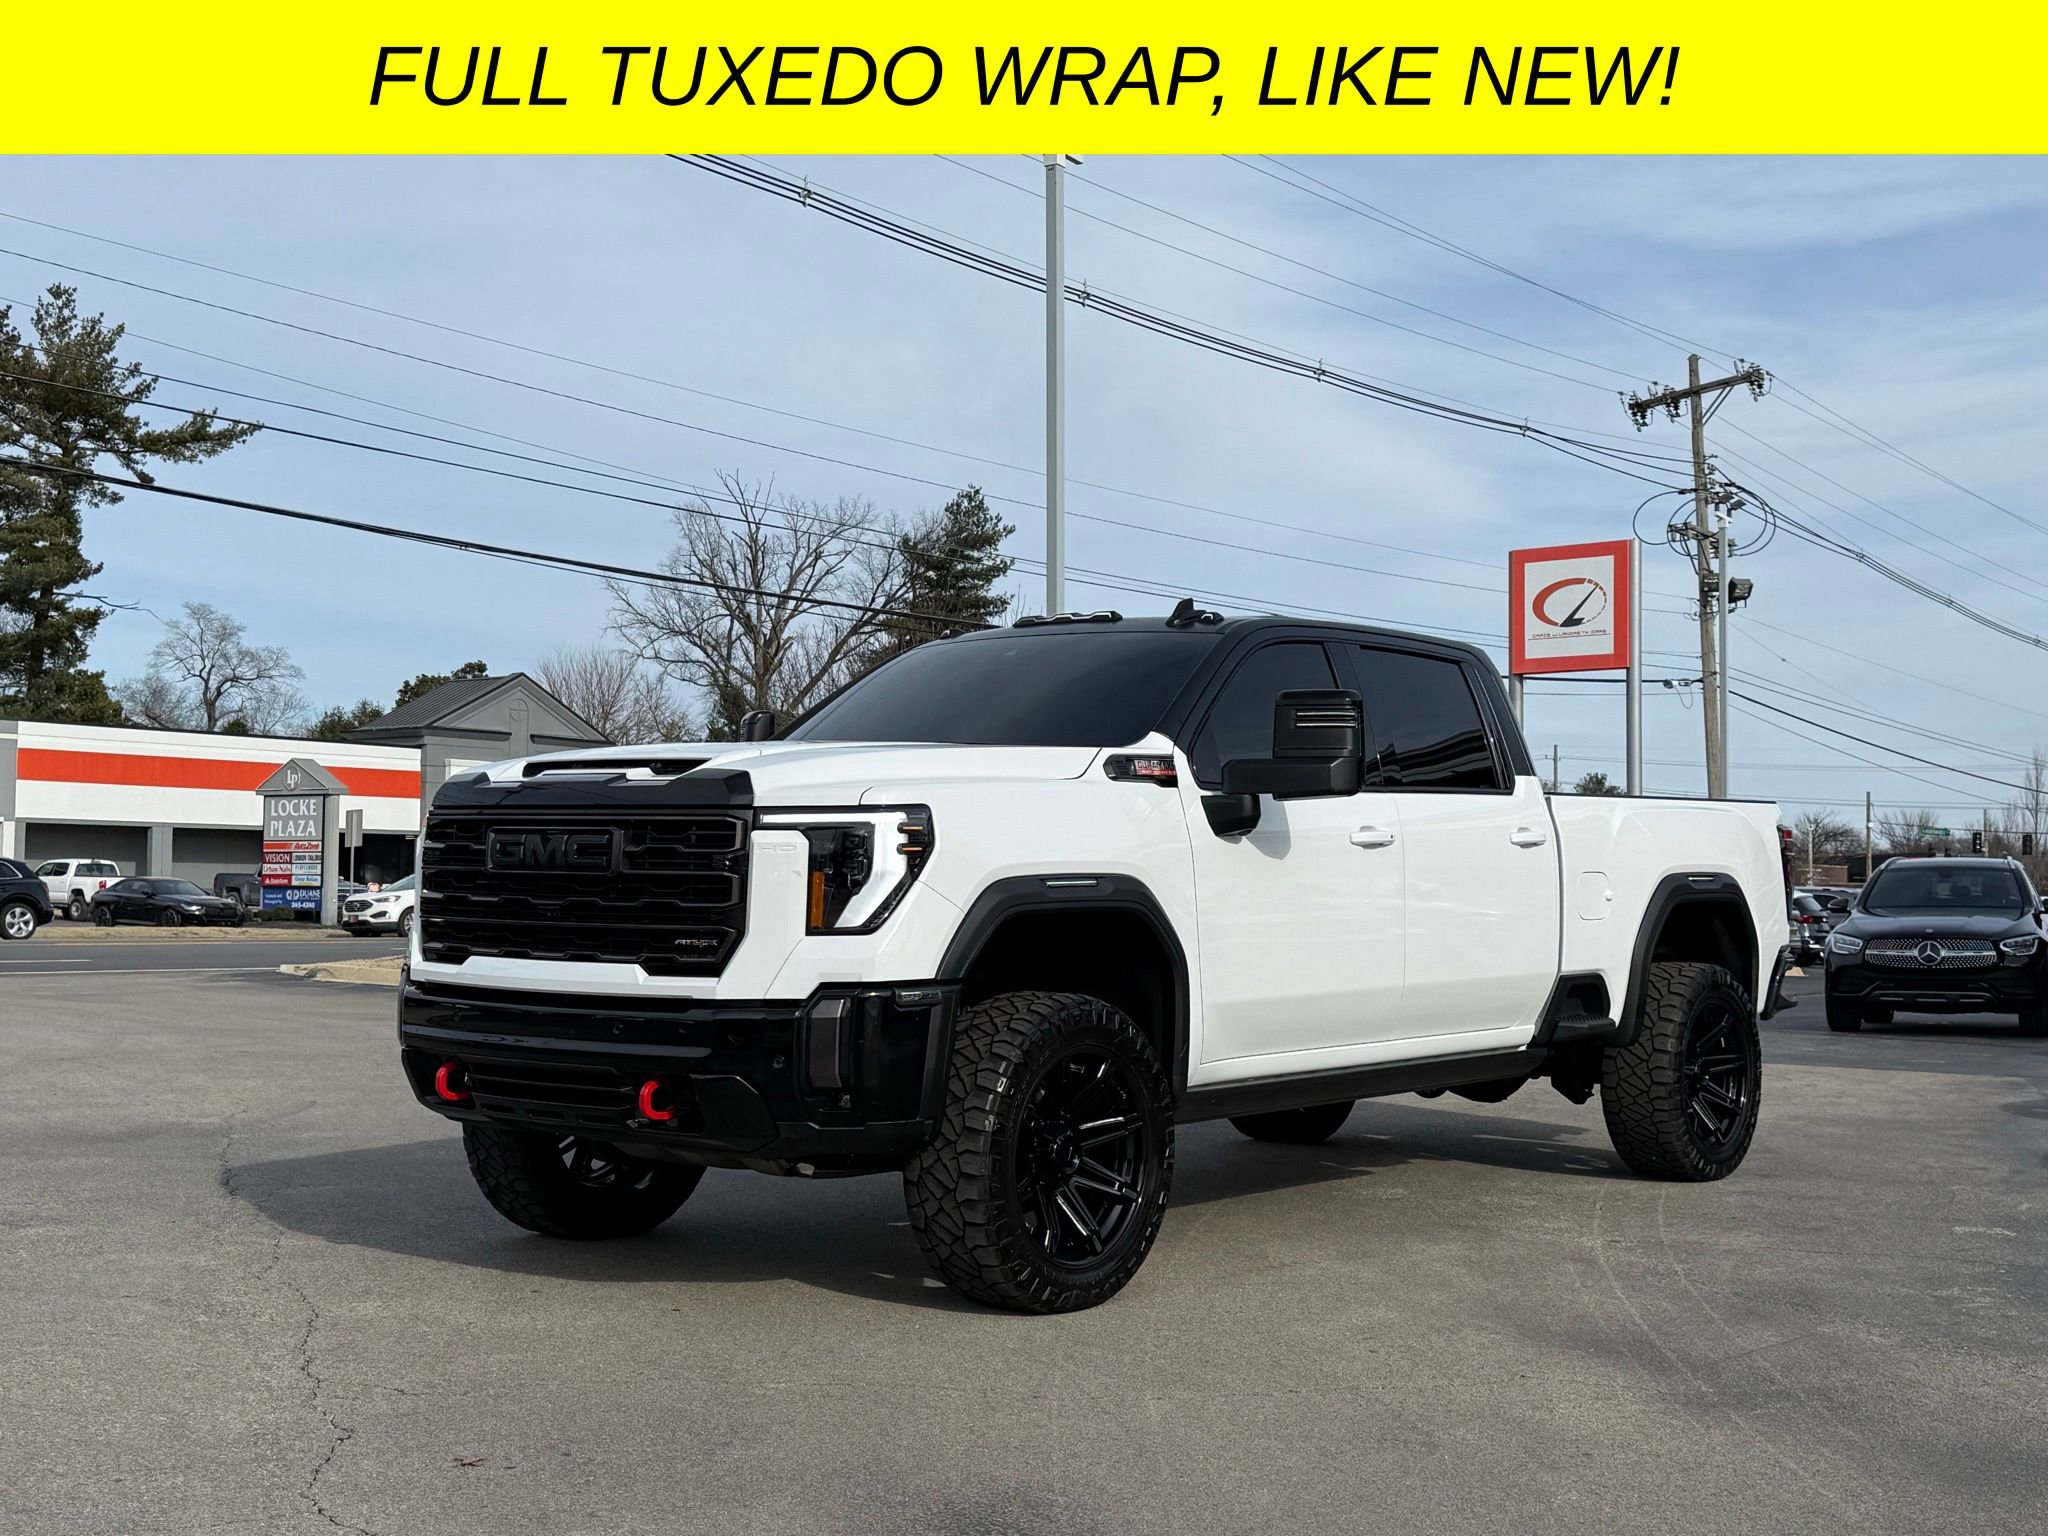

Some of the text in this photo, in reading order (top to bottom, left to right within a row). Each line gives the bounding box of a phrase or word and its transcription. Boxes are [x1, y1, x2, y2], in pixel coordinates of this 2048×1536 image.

[270, 799, 317, 816] LOCKE
[270, 820, 316, 837] PLAZA
[264, 853, 290, 863] VISION
[492, 833, 610, 866] GMC
